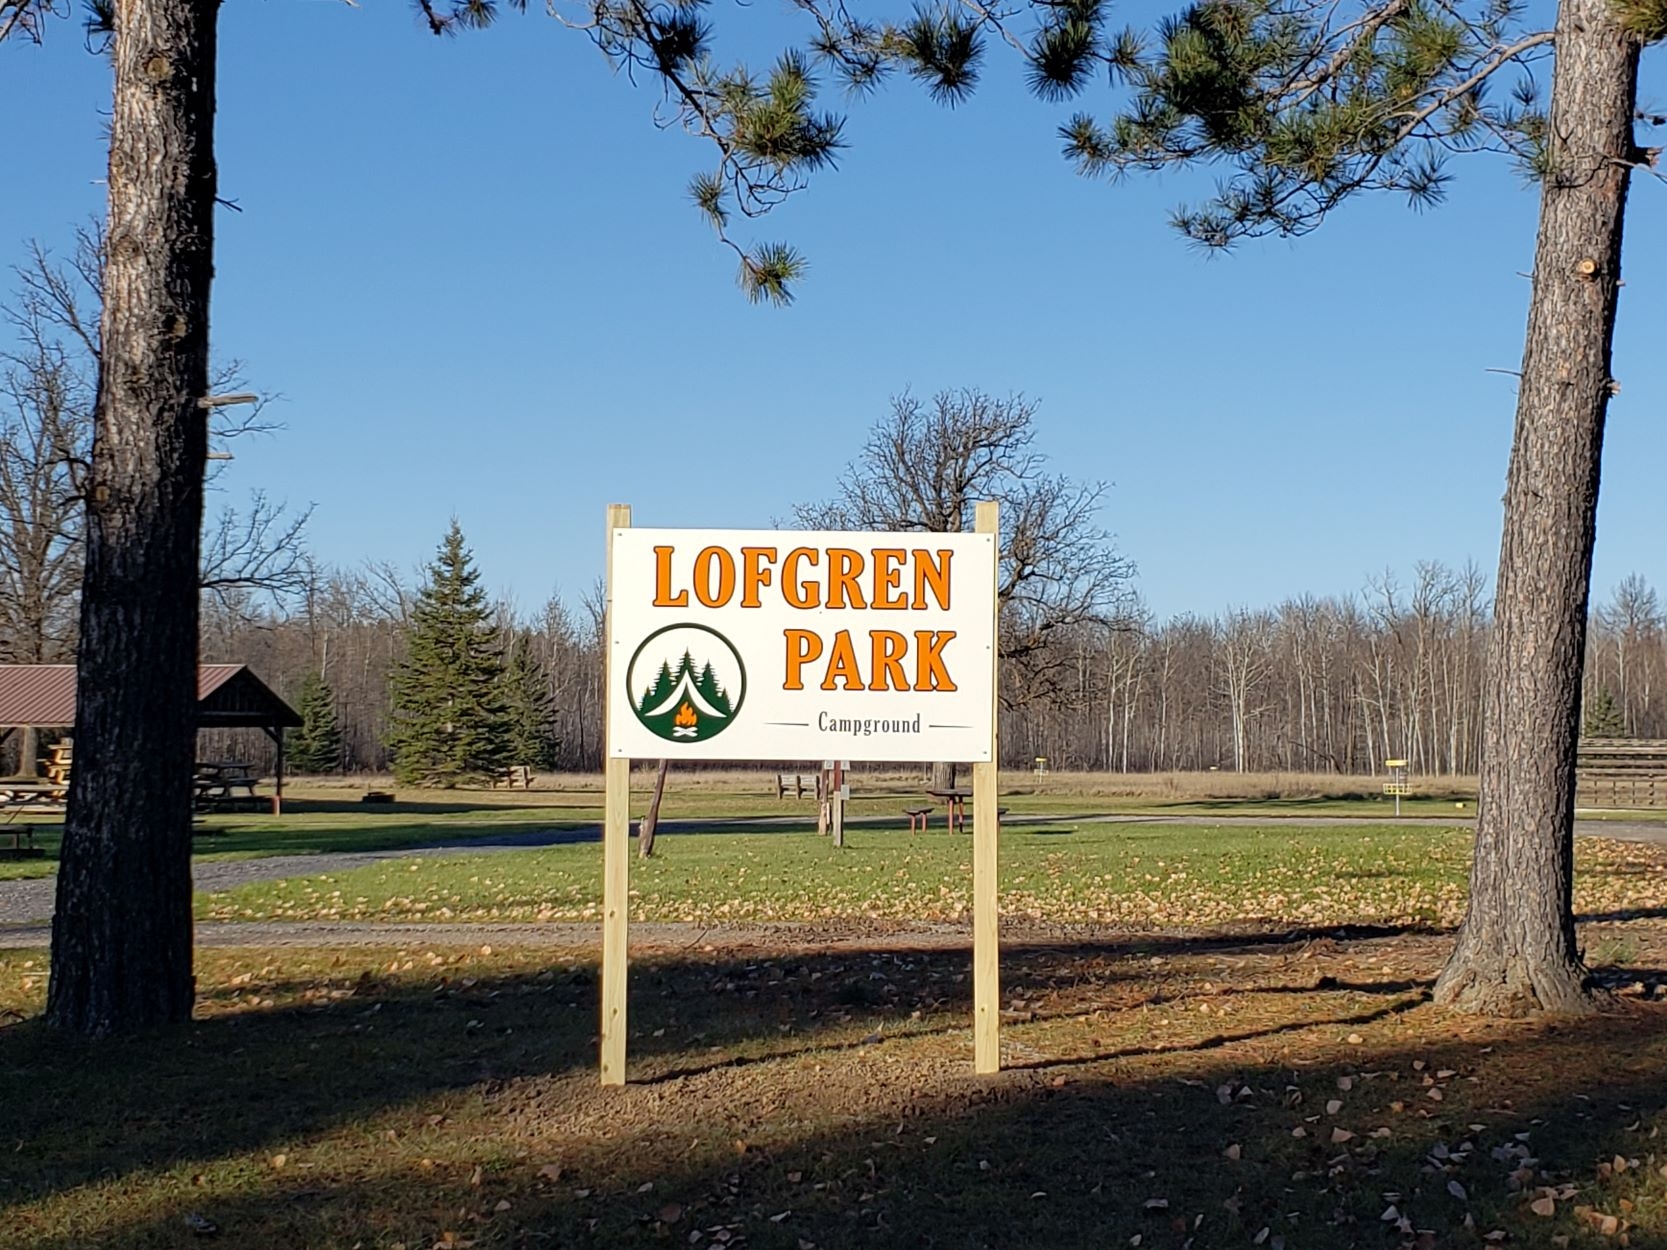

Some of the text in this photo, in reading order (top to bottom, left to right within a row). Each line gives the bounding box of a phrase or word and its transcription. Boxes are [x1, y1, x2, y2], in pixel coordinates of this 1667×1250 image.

[652, 545, 954, 611] LOFGREN
[782, 629, 958, 692] PARK
[818, 711, 921, 736] Campground
